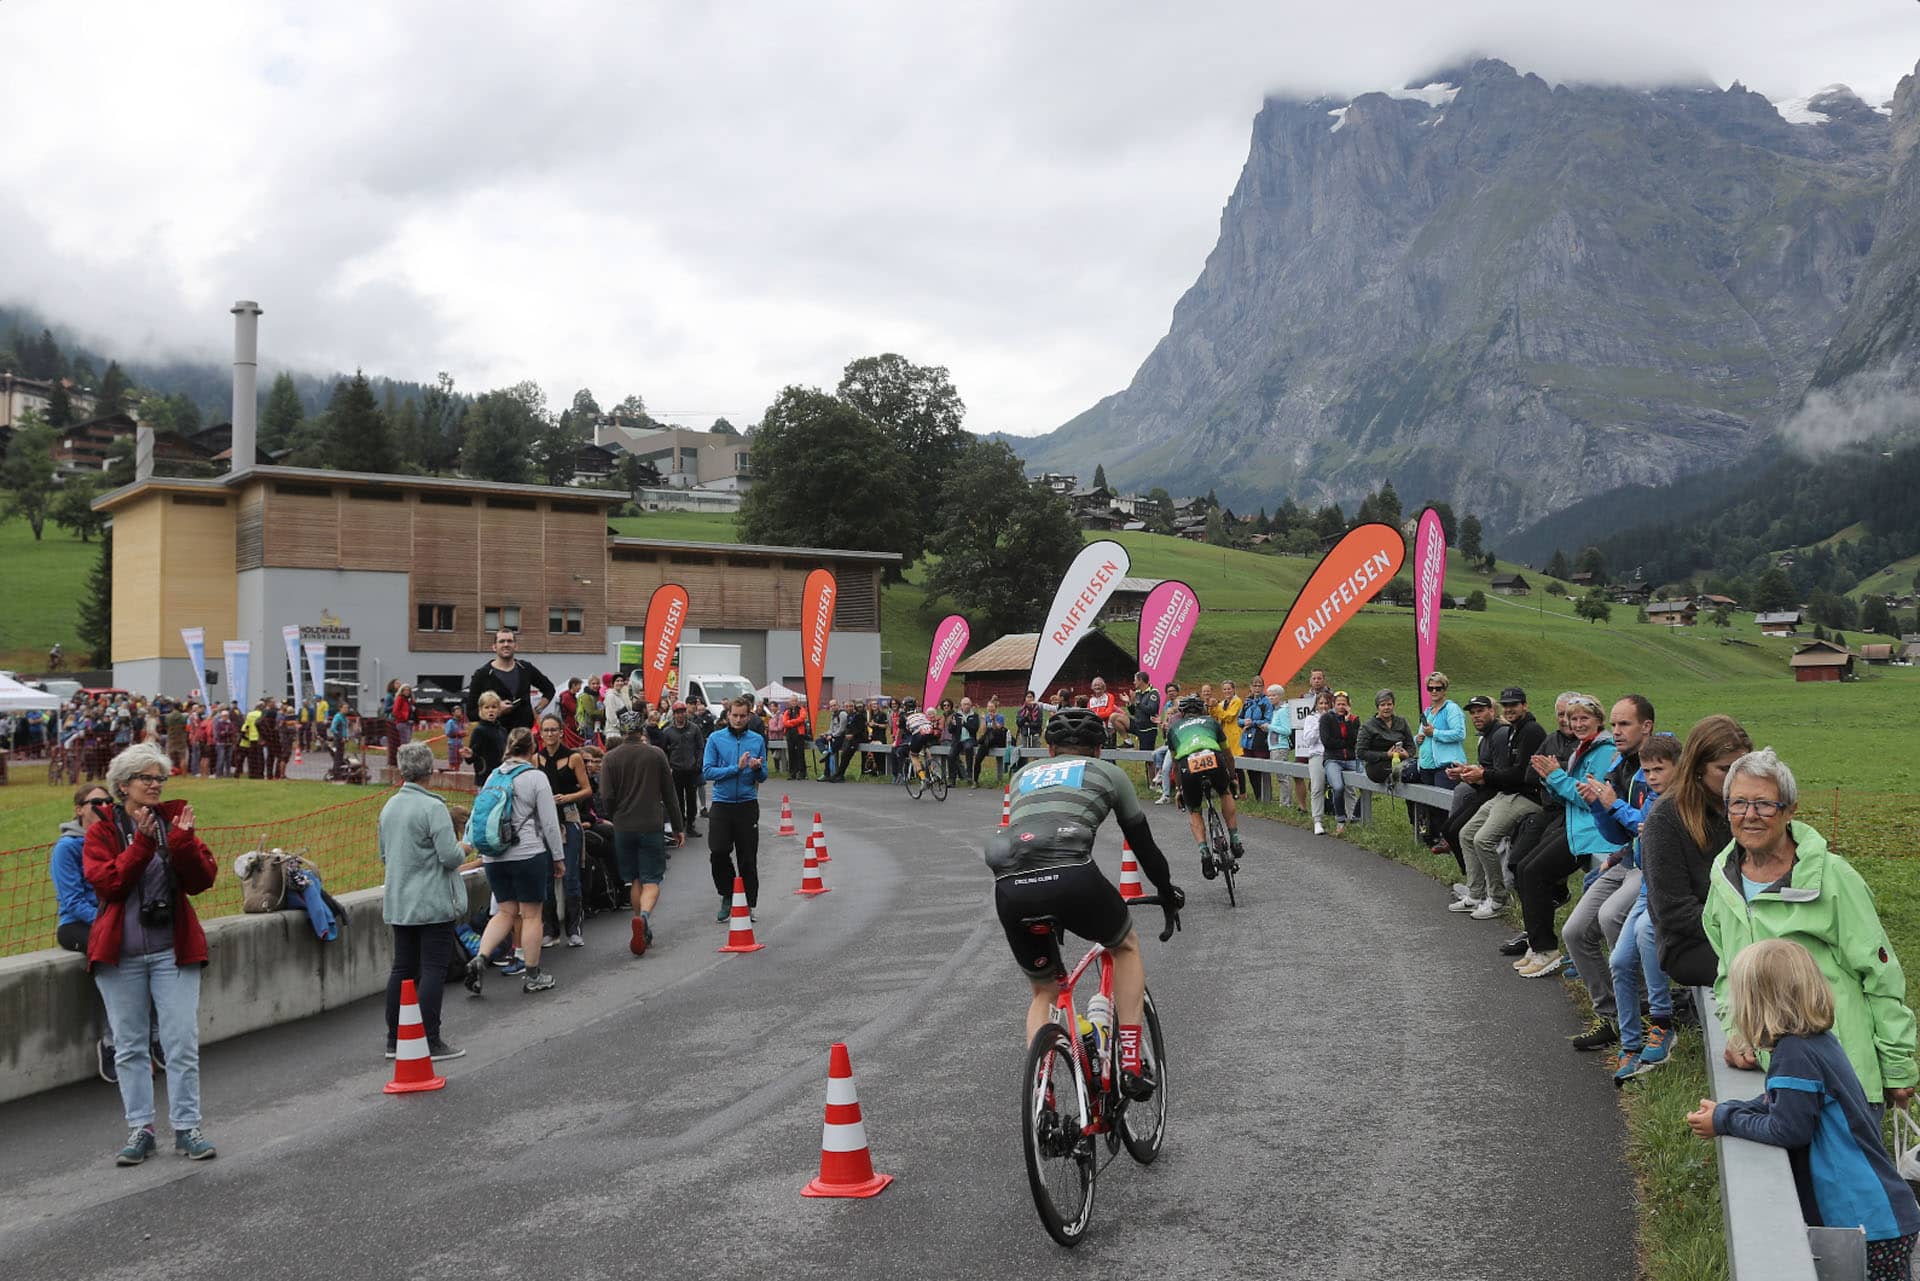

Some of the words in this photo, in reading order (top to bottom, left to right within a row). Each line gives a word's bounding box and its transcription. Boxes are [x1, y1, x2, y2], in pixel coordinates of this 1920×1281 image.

[653, 598, 684, 672] RAIFFEISEN
[811, 584, 833, 667] RAIFFEISEN
[1052, 560, 1119, 646] RAIFFEISEN
[1143, 589, 1183, 667] Schilthorn
[1293, 550, 1391, 649] RAIFFEISEN
[931, 622, 962, 679] Schilthorn
[1191, 756, 1213, 770] 248
[1120, 1029, 1138, 1068] YEAH
